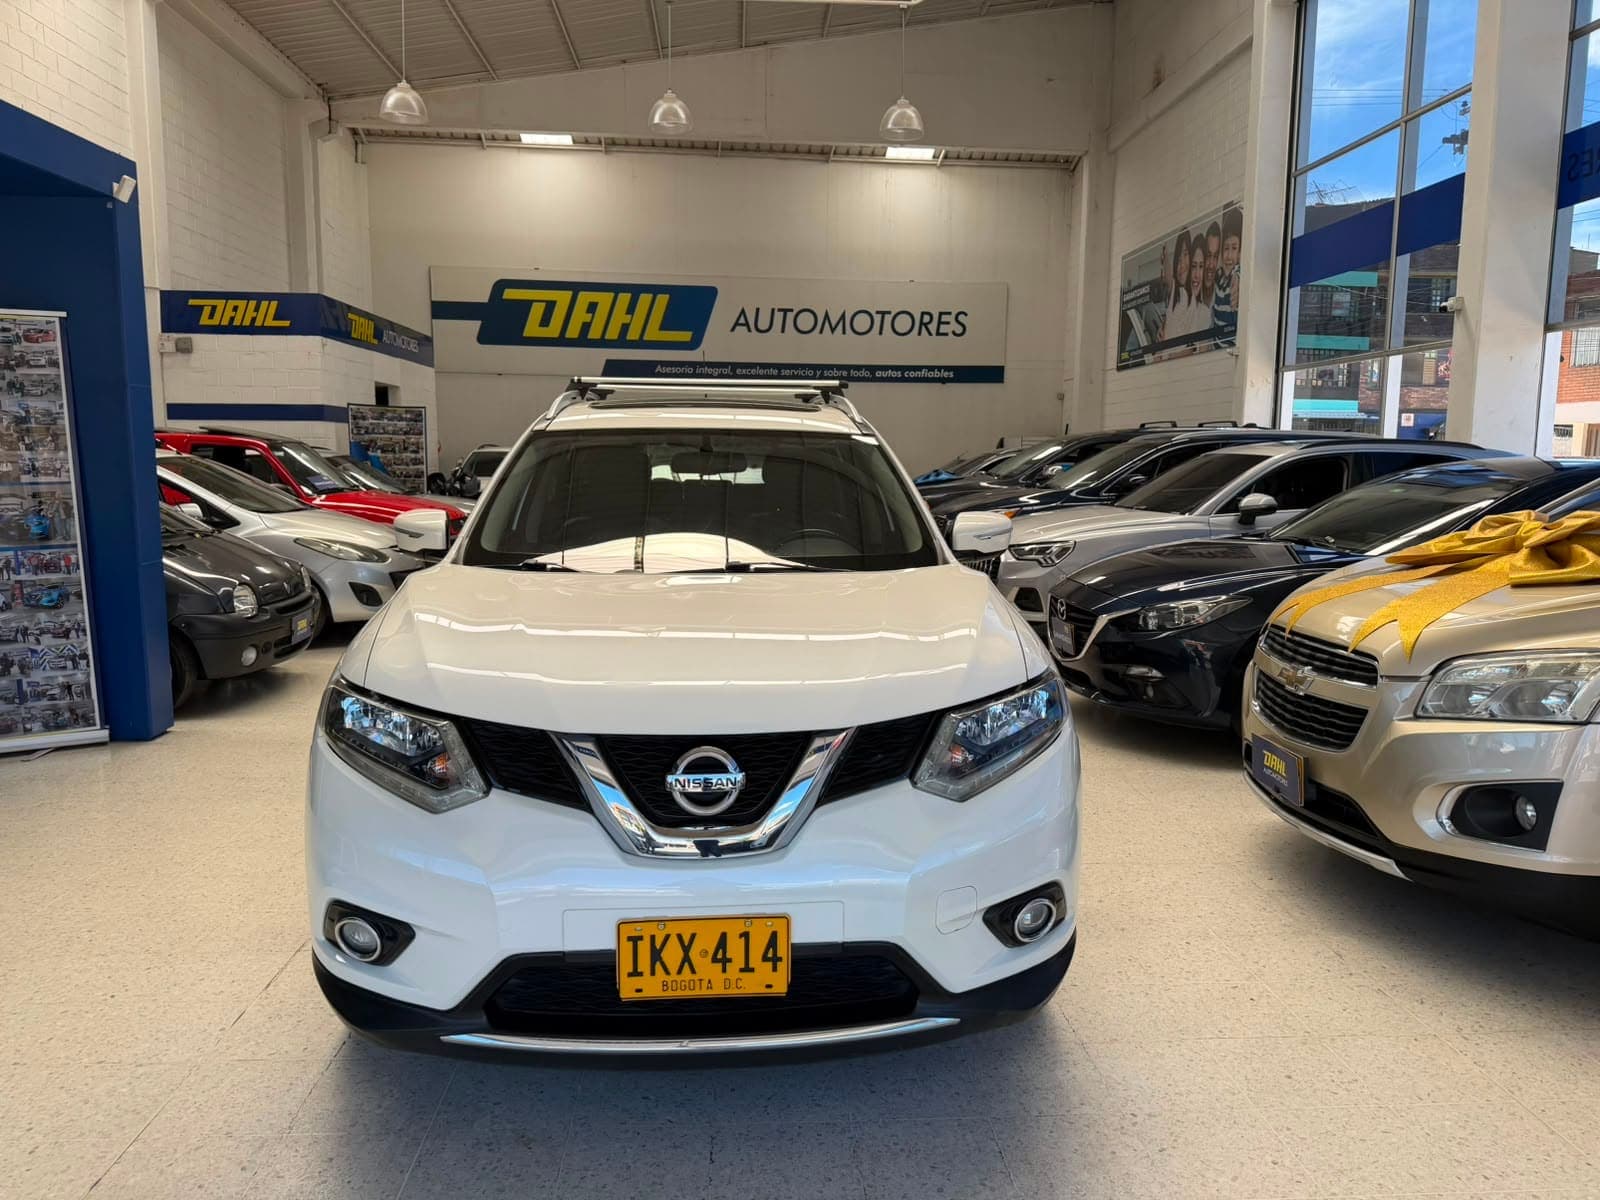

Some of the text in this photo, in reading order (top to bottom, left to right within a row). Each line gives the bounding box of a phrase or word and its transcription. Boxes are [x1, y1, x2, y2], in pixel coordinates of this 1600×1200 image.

[188, 298, 291, 327] DAHL
[502, 288, 693, 342] DAHL
[730, 307, 968, 338] AUTOMOTORES
[347, 312, 378, 345] DAHL
[655, 364, 954, 379] Asesoria integral, excelente servicio y sobre todo, autos confiables
[1263, 749, 1287, 777] DAHL
[673, 777, 737, 789] NISSAN
[626, 930, 783, 977] IKX 414
[661, 978, 747, 992] BOGOTA D.C.
